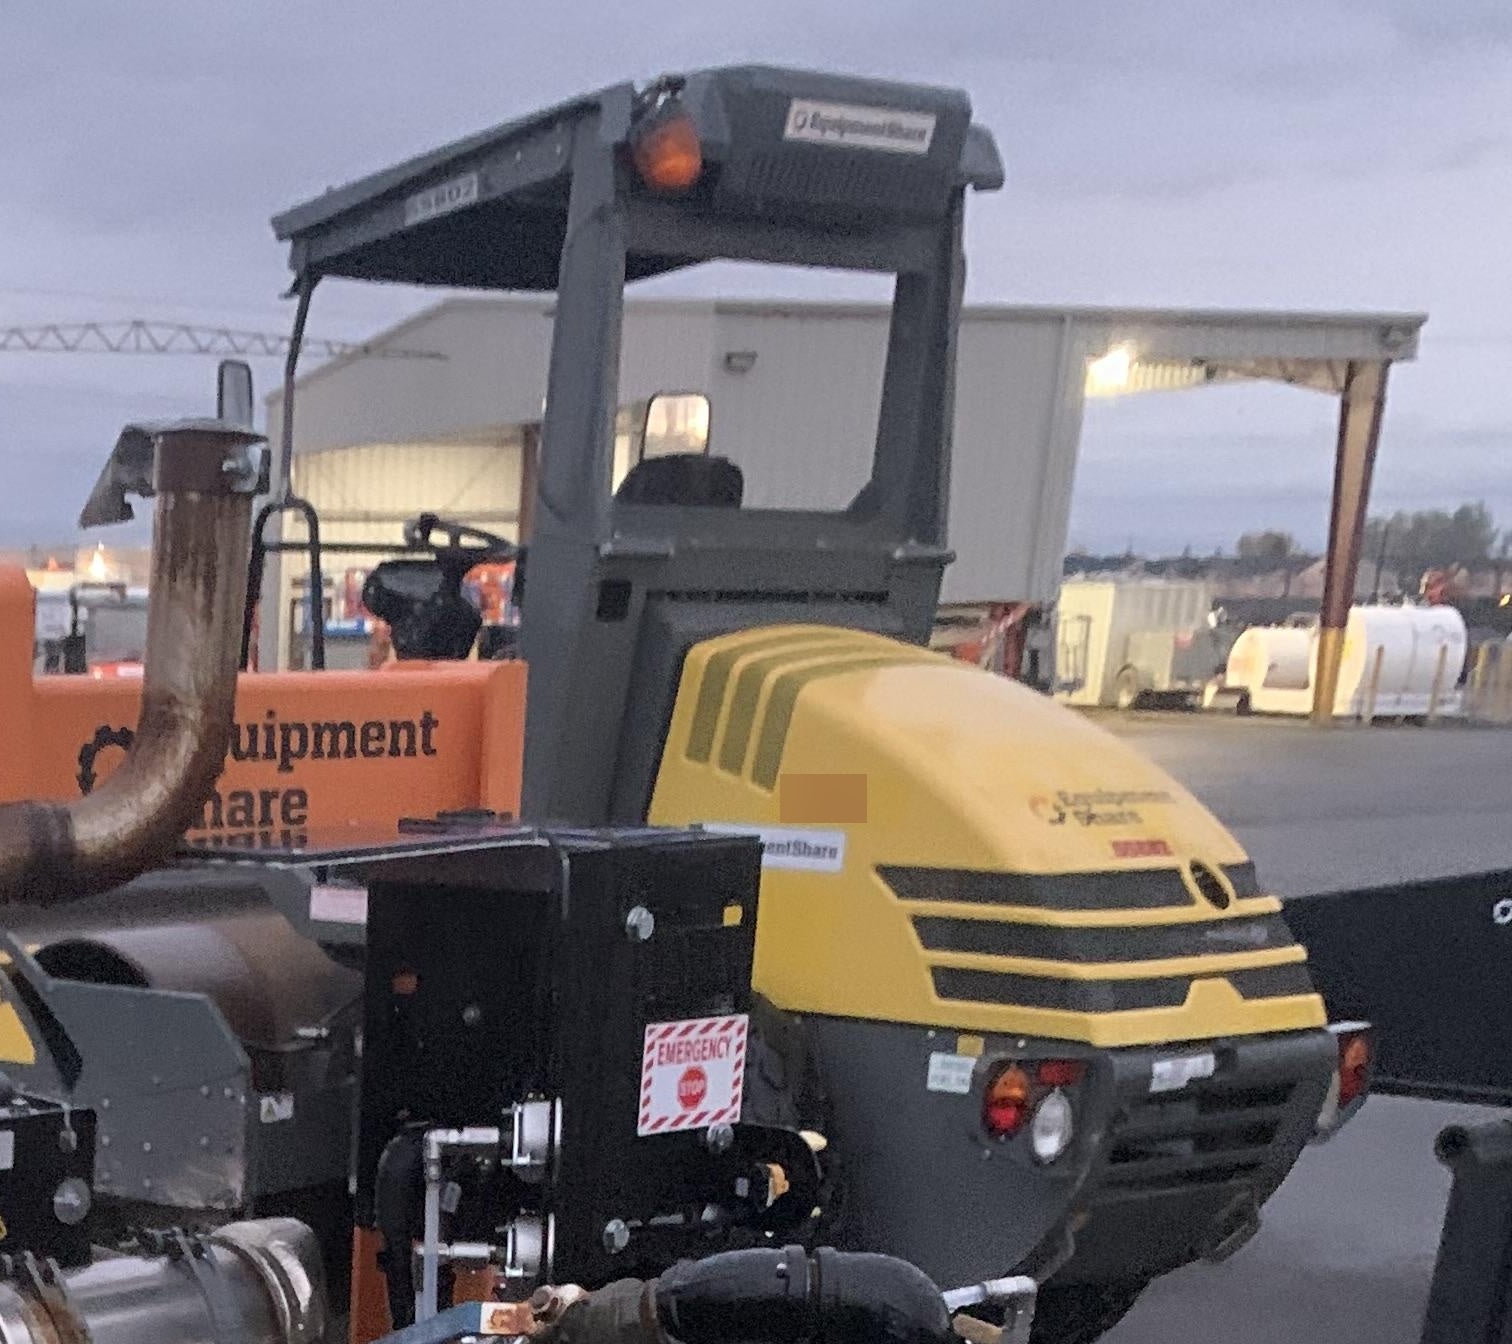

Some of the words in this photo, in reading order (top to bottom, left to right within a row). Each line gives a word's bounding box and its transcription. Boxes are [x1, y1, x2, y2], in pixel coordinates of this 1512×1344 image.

[230, 709, 439, 773] uipment
[190, 788, 308, 829] hare
[657, 1036, 732, 1066] EMERGENCY
